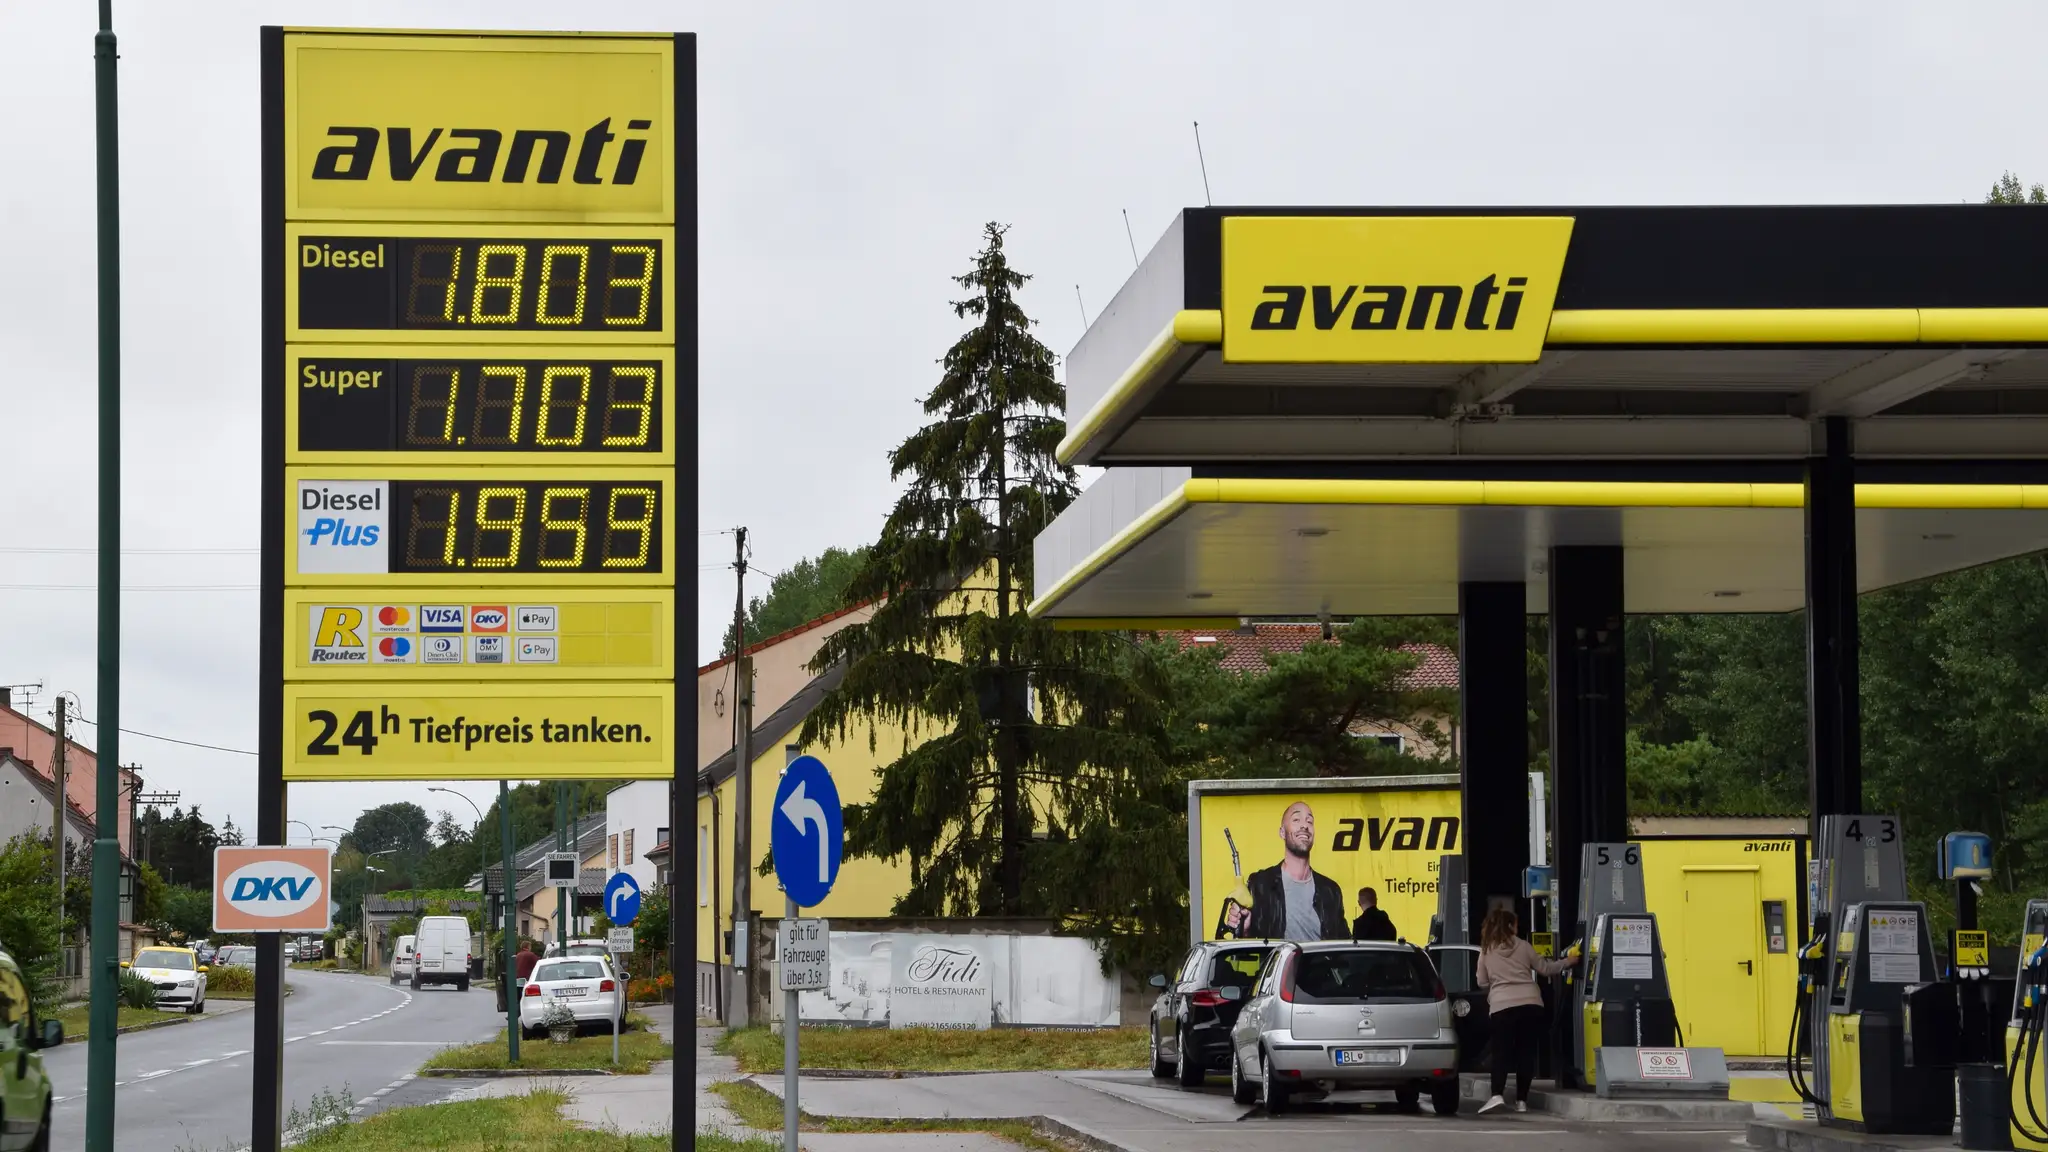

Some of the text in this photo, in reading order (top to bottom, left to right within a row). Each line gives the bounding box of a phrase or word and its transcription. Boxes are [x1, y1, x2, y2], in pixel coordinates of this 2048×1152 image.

[311, 117, 652, 185] avanti
[303, 244, 656, 325] Diesel 1.803
[1251, 273, 1529, 331] avanti
[303, 365, 656, 446] Super 1.703
[302, 488, 656, 567] Diesel 1.959
[304, 518, 380, 546] Plus
[424, 609, 462, 623] VISA
[475, 614, 503, 624] DKV
[532, 614, 550, 625] Pay
[311, 648, 367, 662] Routex
[534, 645, 551, 656] Pay
[307, 704, 652, 756] 24h Tiefpreis tanken.
[1332, 816, 1460, 851] avan
[1845, 820, 1896, 843] 4 3
[1598, 847, 1638, 865] 5 6
[1743, 841, 1792, 852] avanti
[231, 877, 315, 901] DKV
[1385, 878, 1439, 897] Tiefprei
[789, 925, 819, 944] gilt für
[783, 948, 826, 965] Fahrzeuge
[908, 946, 980, 982] Fidi
[787, 969, 822, 986] über 3,5t
[895, 986, 986, 995] HOTEL & RESTAURANT
[1343, 1051, 1357, 1062] BL
